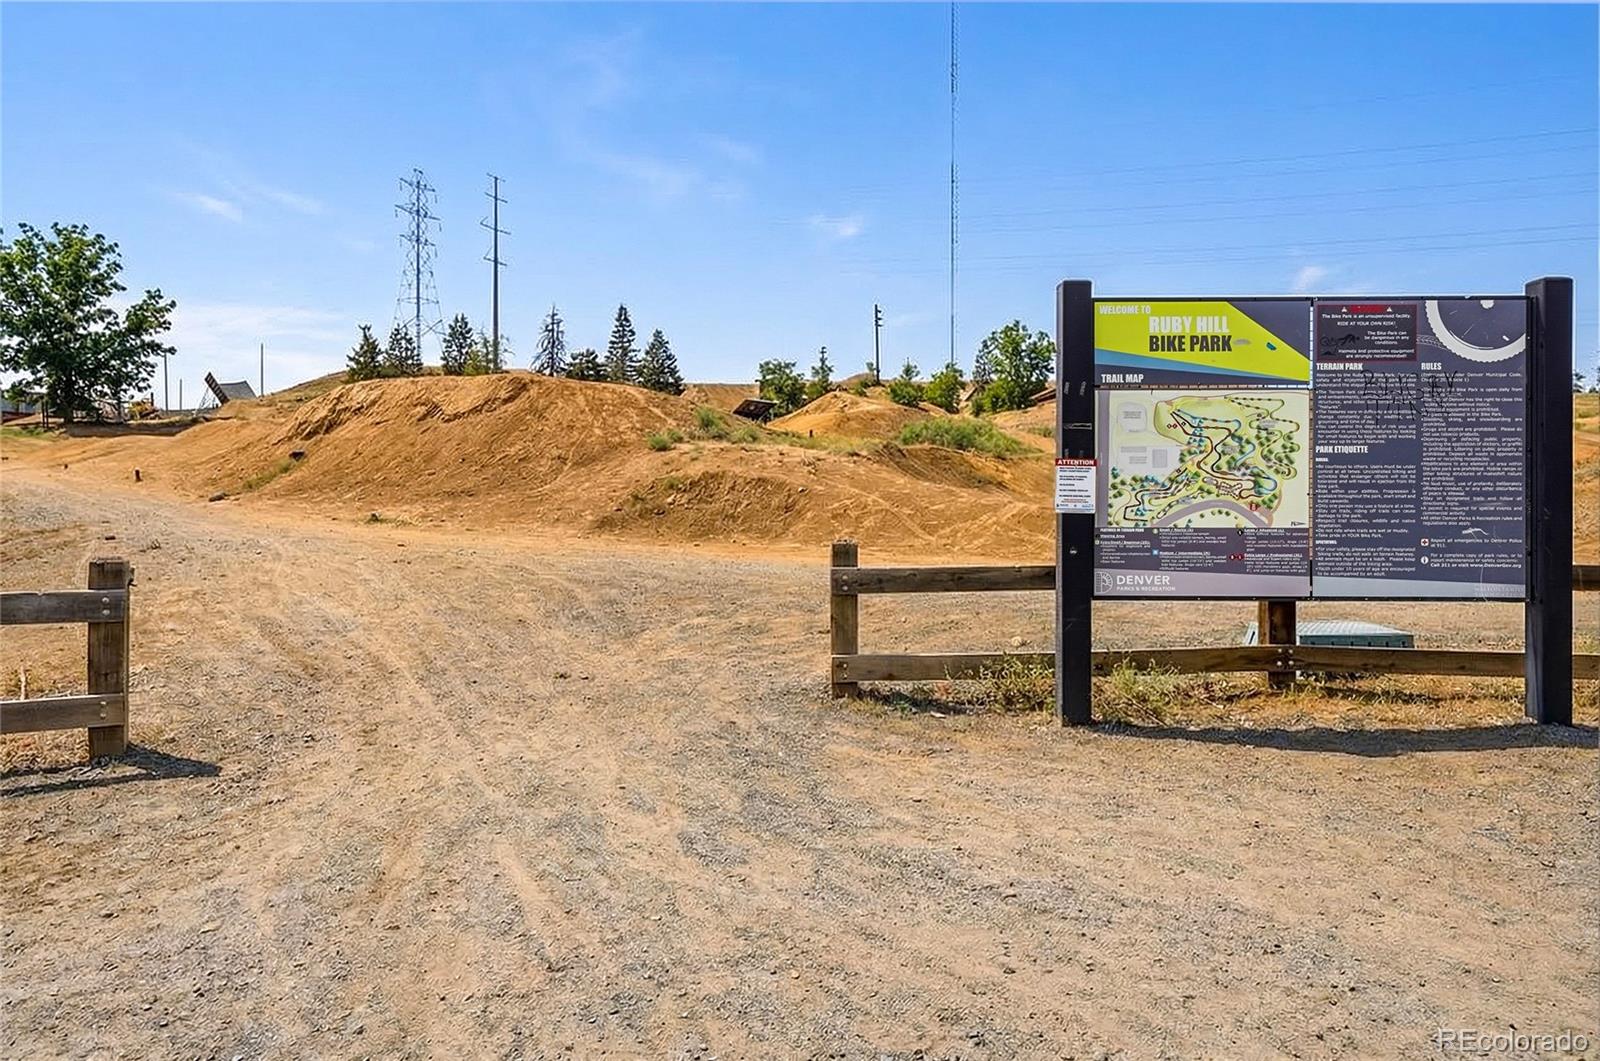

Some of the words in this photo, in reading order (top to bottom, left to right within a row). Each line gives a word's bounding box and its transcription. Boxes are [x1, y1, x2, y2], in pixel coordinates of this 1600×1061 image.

[1149, 316, 1192, 333] RUBY
[1196, 316, 1230, 333] HILL
[1149, 336, 1185, 352] BIKE
[1190, 336, 1232, 352] PARK
[1101, 374, 1124, 383] TRAIL
[1126, 374, 1144, 383] MAP
[1117, 576, 1170, 584] DENVER
